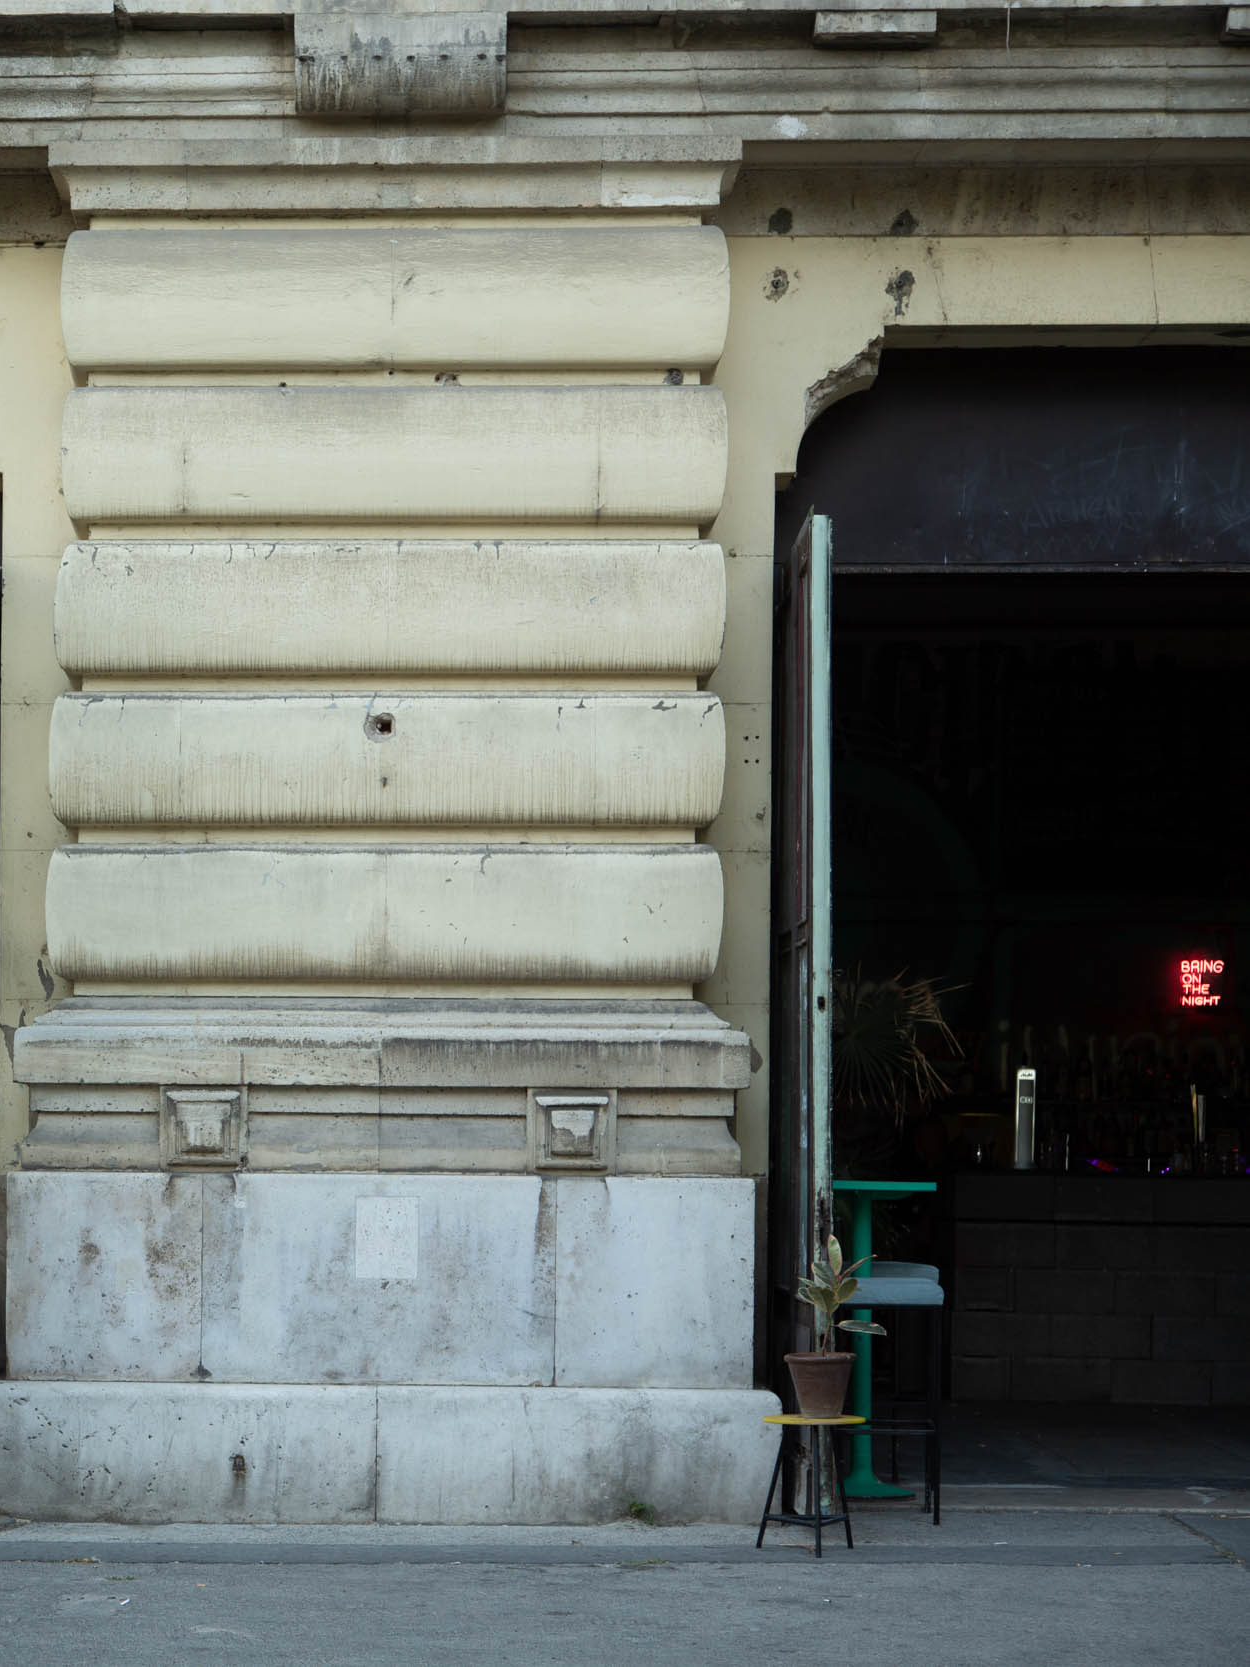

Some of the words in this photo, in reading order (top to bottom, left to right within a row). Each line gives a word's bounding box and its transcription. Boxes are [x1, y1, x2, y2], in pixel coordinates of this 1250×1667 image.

[1181, 959, 1225, 974] BRING
[1182, 973, 1202, 984] ON
[1182, 983, 1211, 995] THE
[1182, 995, 1221, 1006] NIGHT
